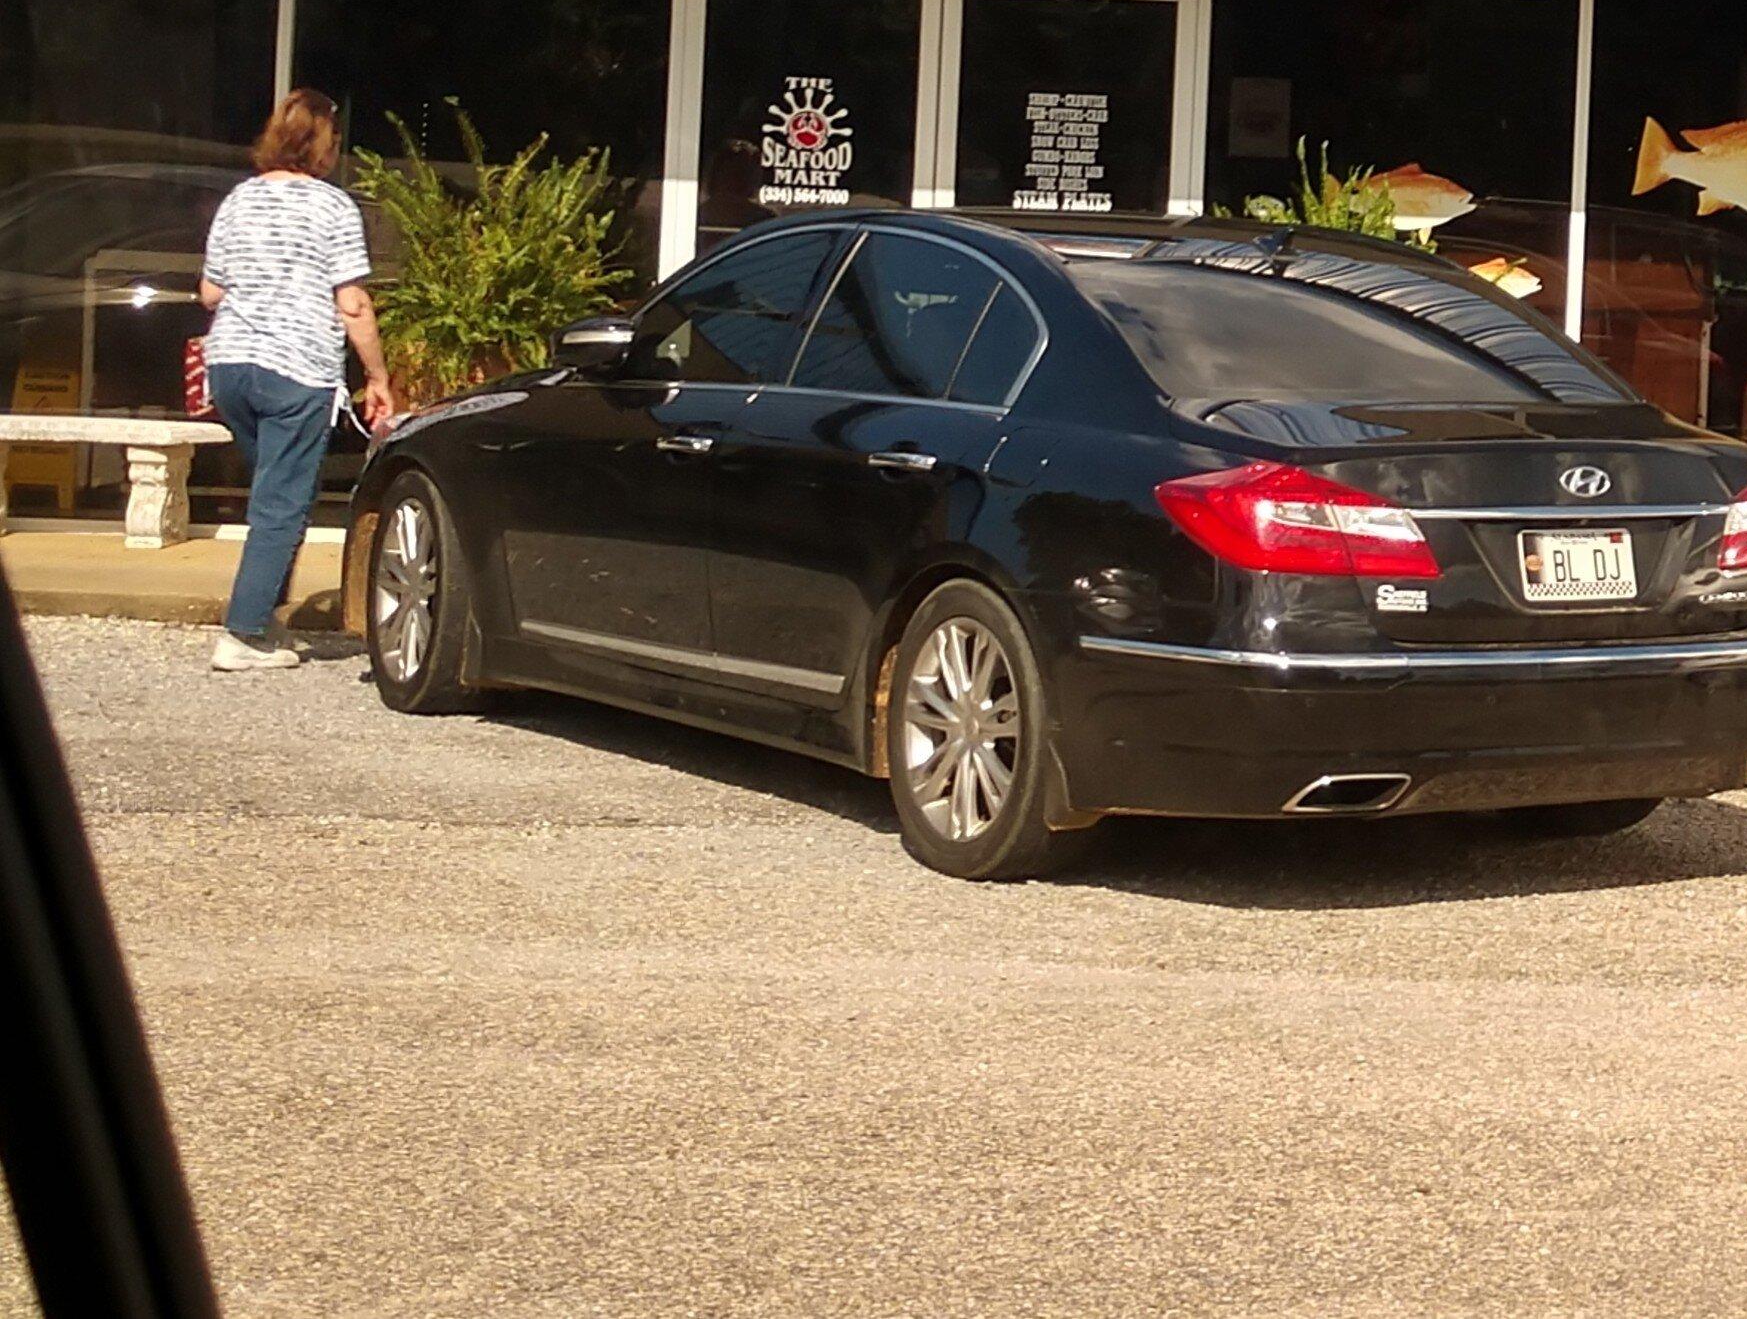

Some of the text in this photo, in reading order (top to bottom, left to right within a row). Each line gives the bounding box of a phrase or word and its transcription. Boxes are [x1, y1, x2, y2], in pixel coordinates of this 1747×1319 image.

[785, 76, 834, 92] THE
[761, 136, 853, 171] SEAFOOD
[774, 169, 841, 186] MART
[759, 185, 792, 205] (334)
[1012, 190, 1113, 212] STEAM PLATES
[1553, 548, 1621, 583] BL DJ
